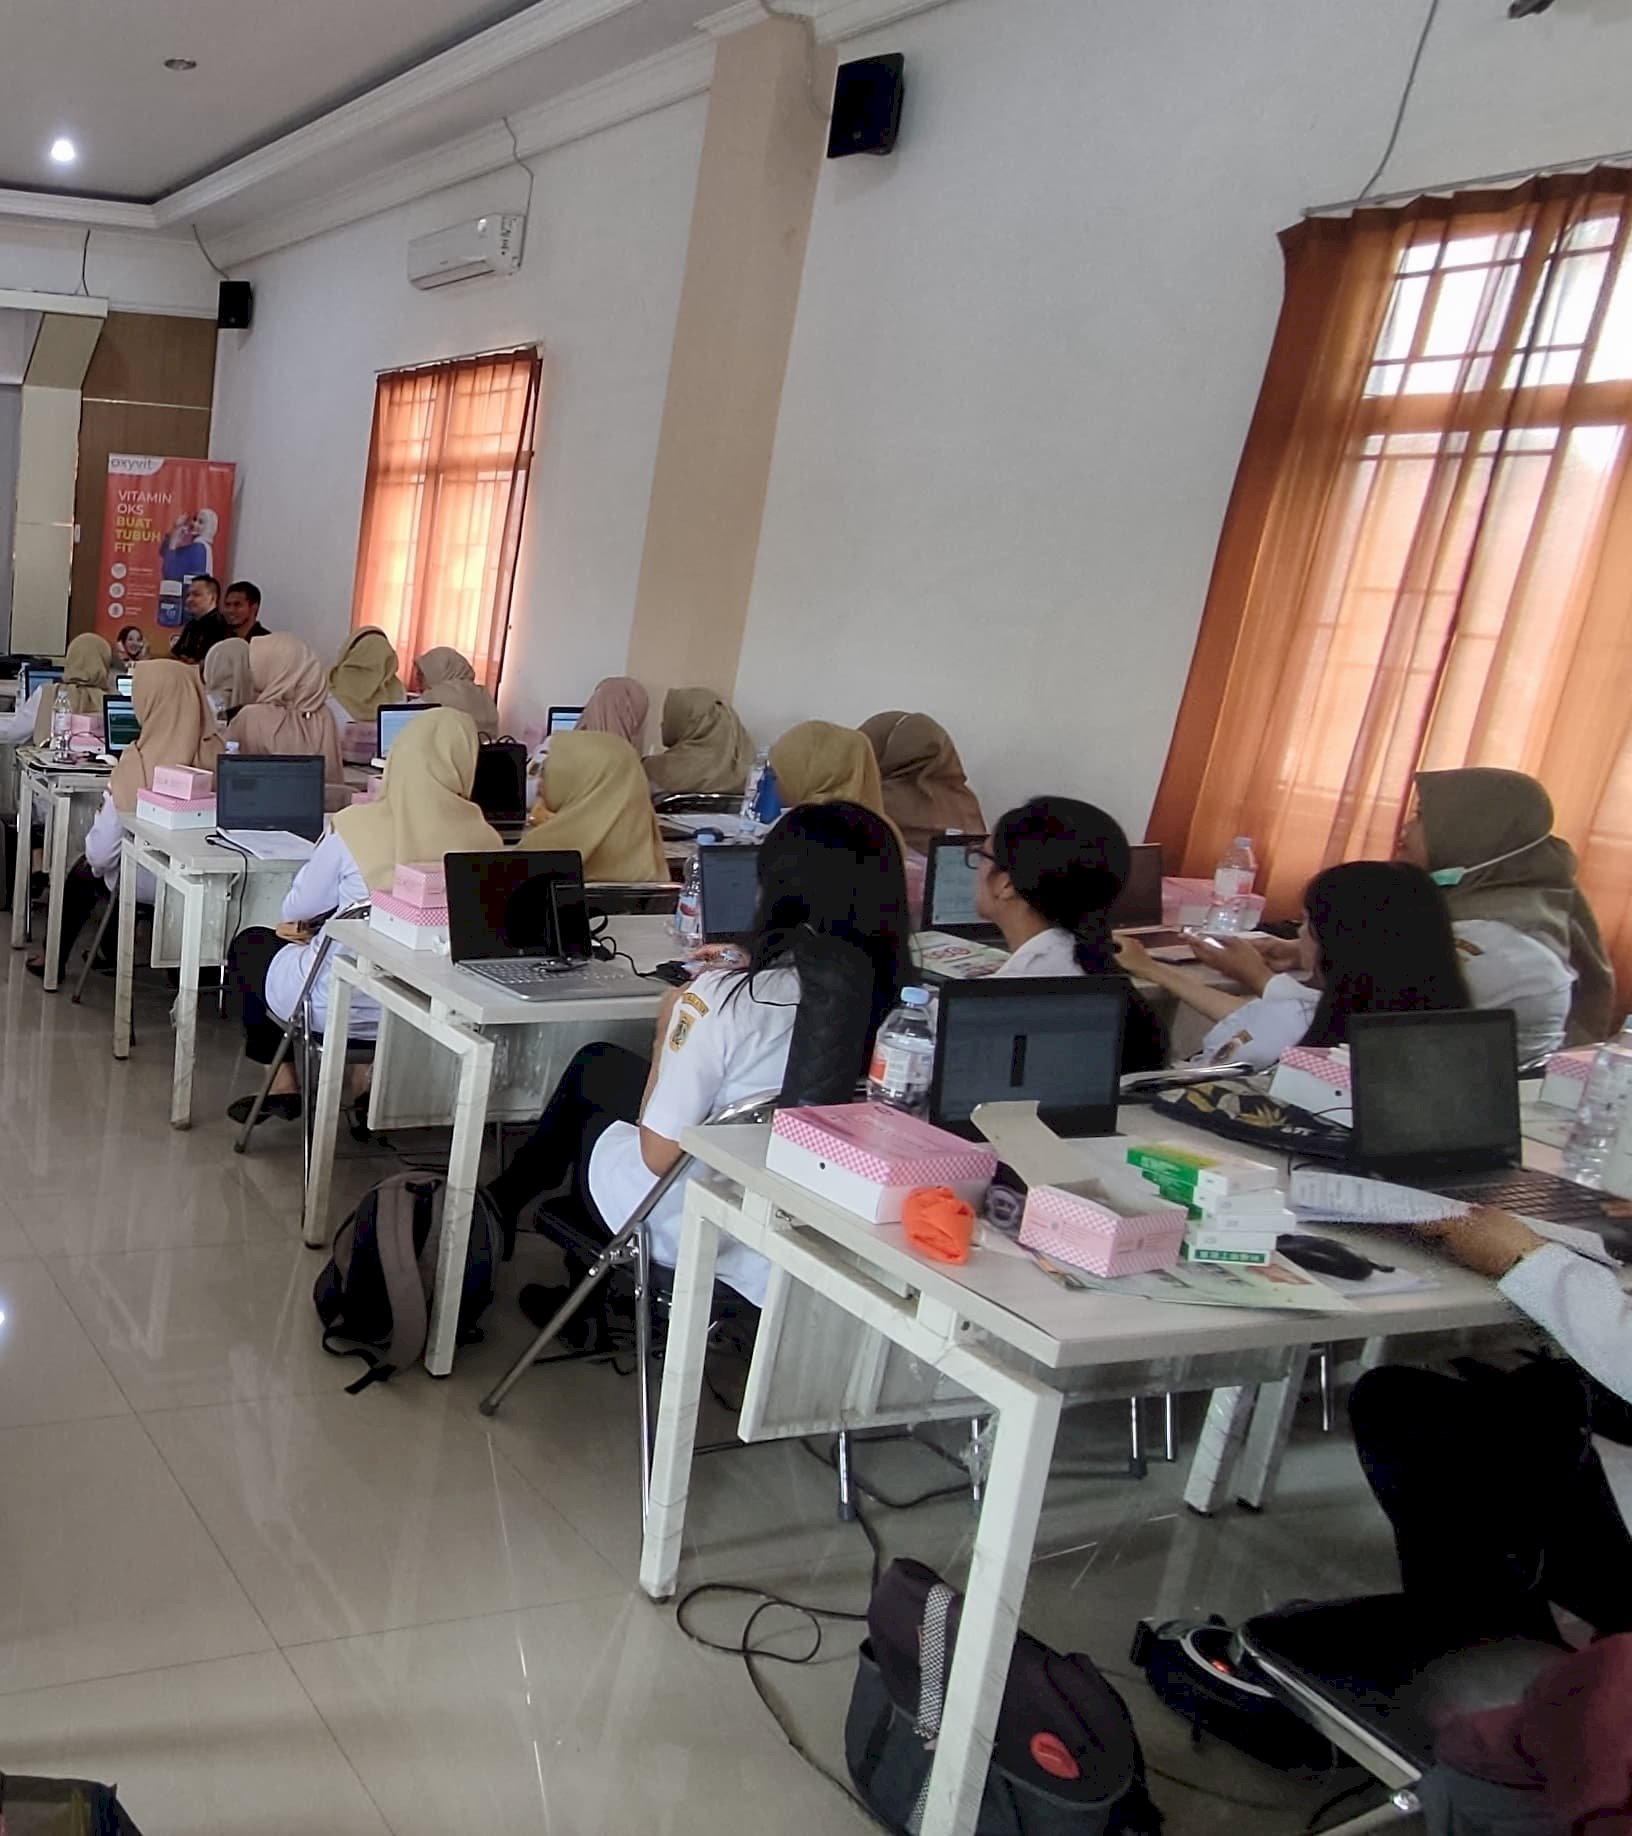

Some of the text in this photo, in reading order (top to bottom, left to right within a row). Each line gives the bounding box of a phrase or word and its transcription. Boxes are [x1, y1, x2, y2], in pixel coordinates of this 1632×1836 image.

[111, 457, 152, 470] oxyvit
[118, 489, 172, 504] VITAMIN
[117, 503, 144, 515] OKS
[116, 516, 153, 529] BUAT
[115, 529, 162, 542] TUBUH
[115, 542, 135, 553] FIT
